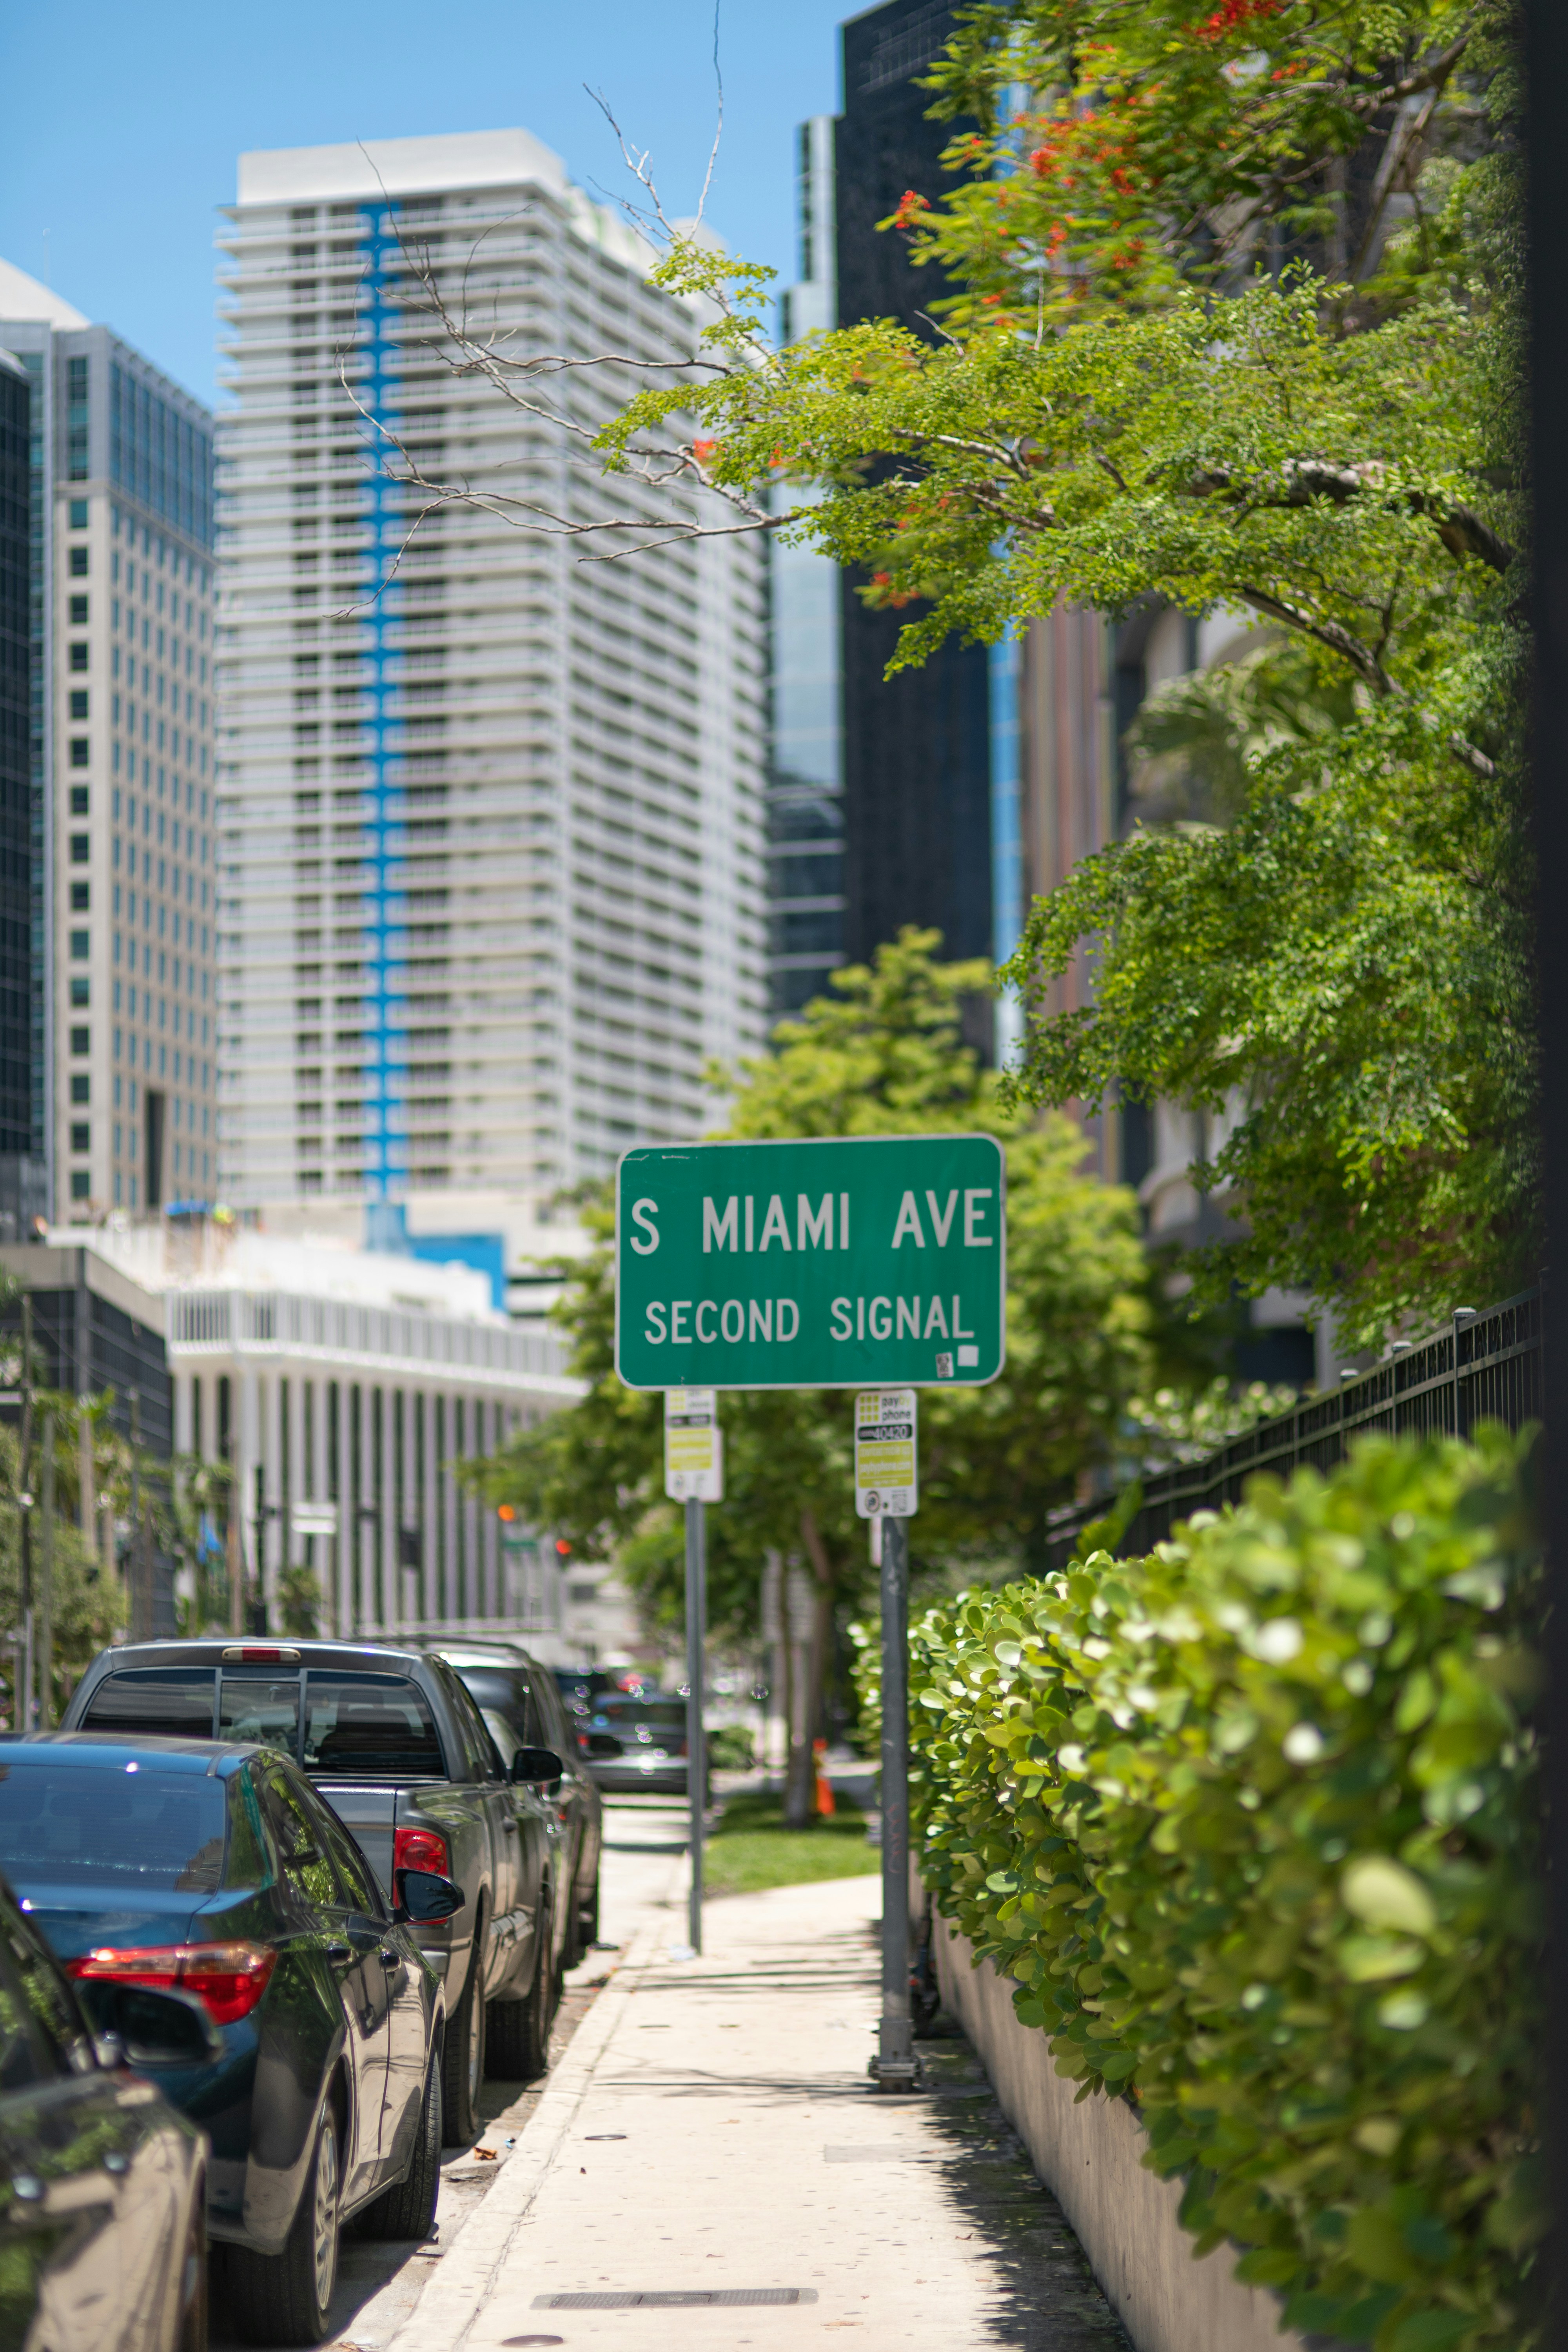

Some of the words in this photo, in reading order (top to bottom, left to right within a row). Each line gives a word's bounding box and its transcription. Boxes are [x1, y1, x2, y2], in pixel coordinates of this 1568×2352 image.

[630, 1198, 659, 1254] S
[703, 1193, 849, 1252] MIAMI
[892, 1189, 992, 1248] AVE
[645, 1299, 799, 1344] SECOND
[830, 1295, 974, 1340] SIGNAL
[882, 1409, 911, 1422] phone
[874, 1426, 908, 1439] 40420
